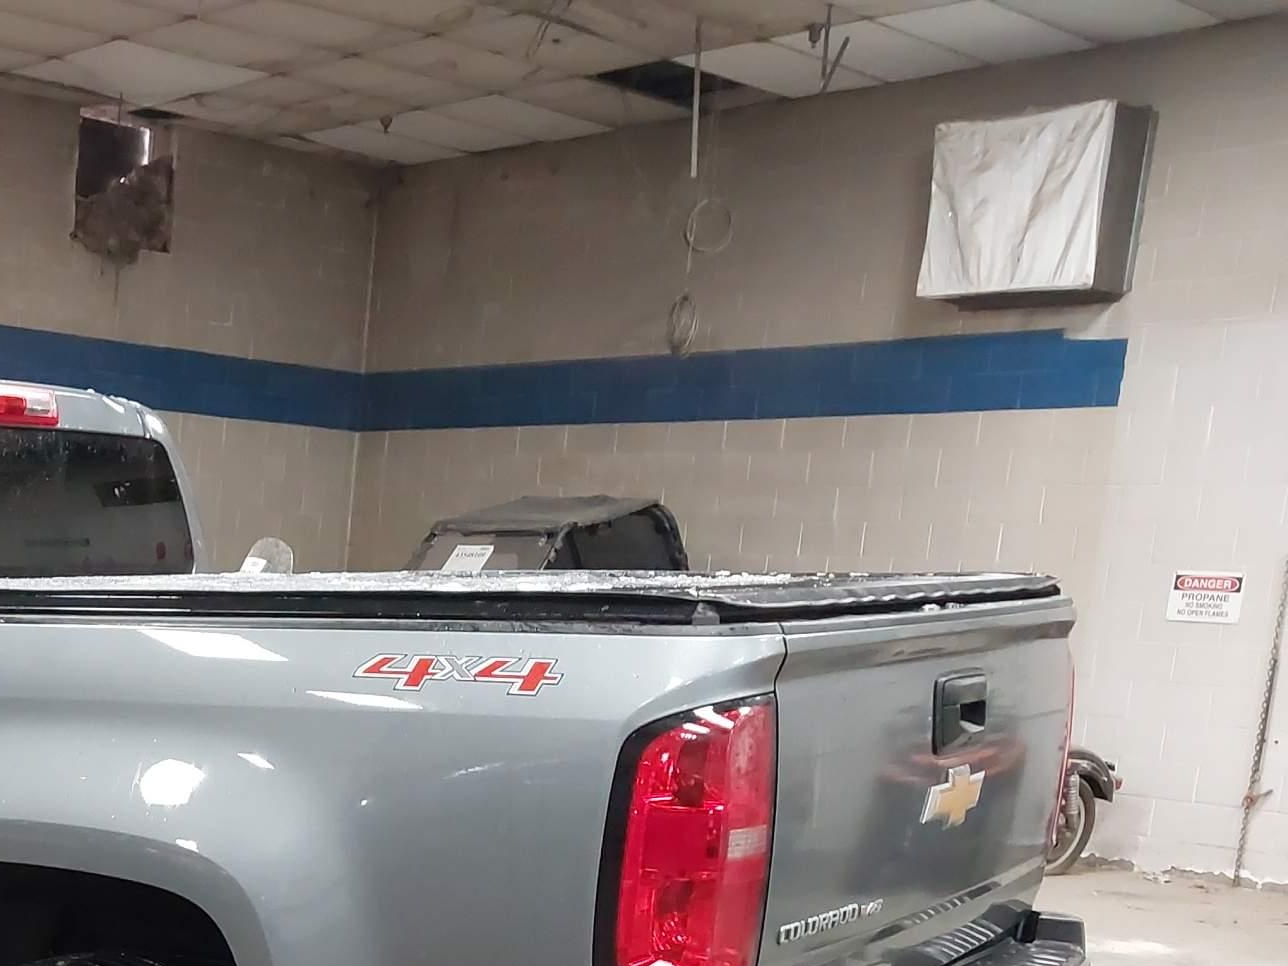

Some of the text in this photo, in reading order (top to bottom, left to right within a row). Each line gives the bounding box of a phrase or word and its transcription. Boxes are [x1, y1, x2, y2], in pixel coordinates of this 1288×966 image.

[1184, 578, 1232, 590] DANGER
[1181, 592, 1230, 603] PROPANE
[1195, 602, 1223, 610] SMOKING
[1187, 609, 1204, 617] OPEN
[1204, 610, 1229, 618] FLAMES
[777, 903, 859, 943] COLORADO
